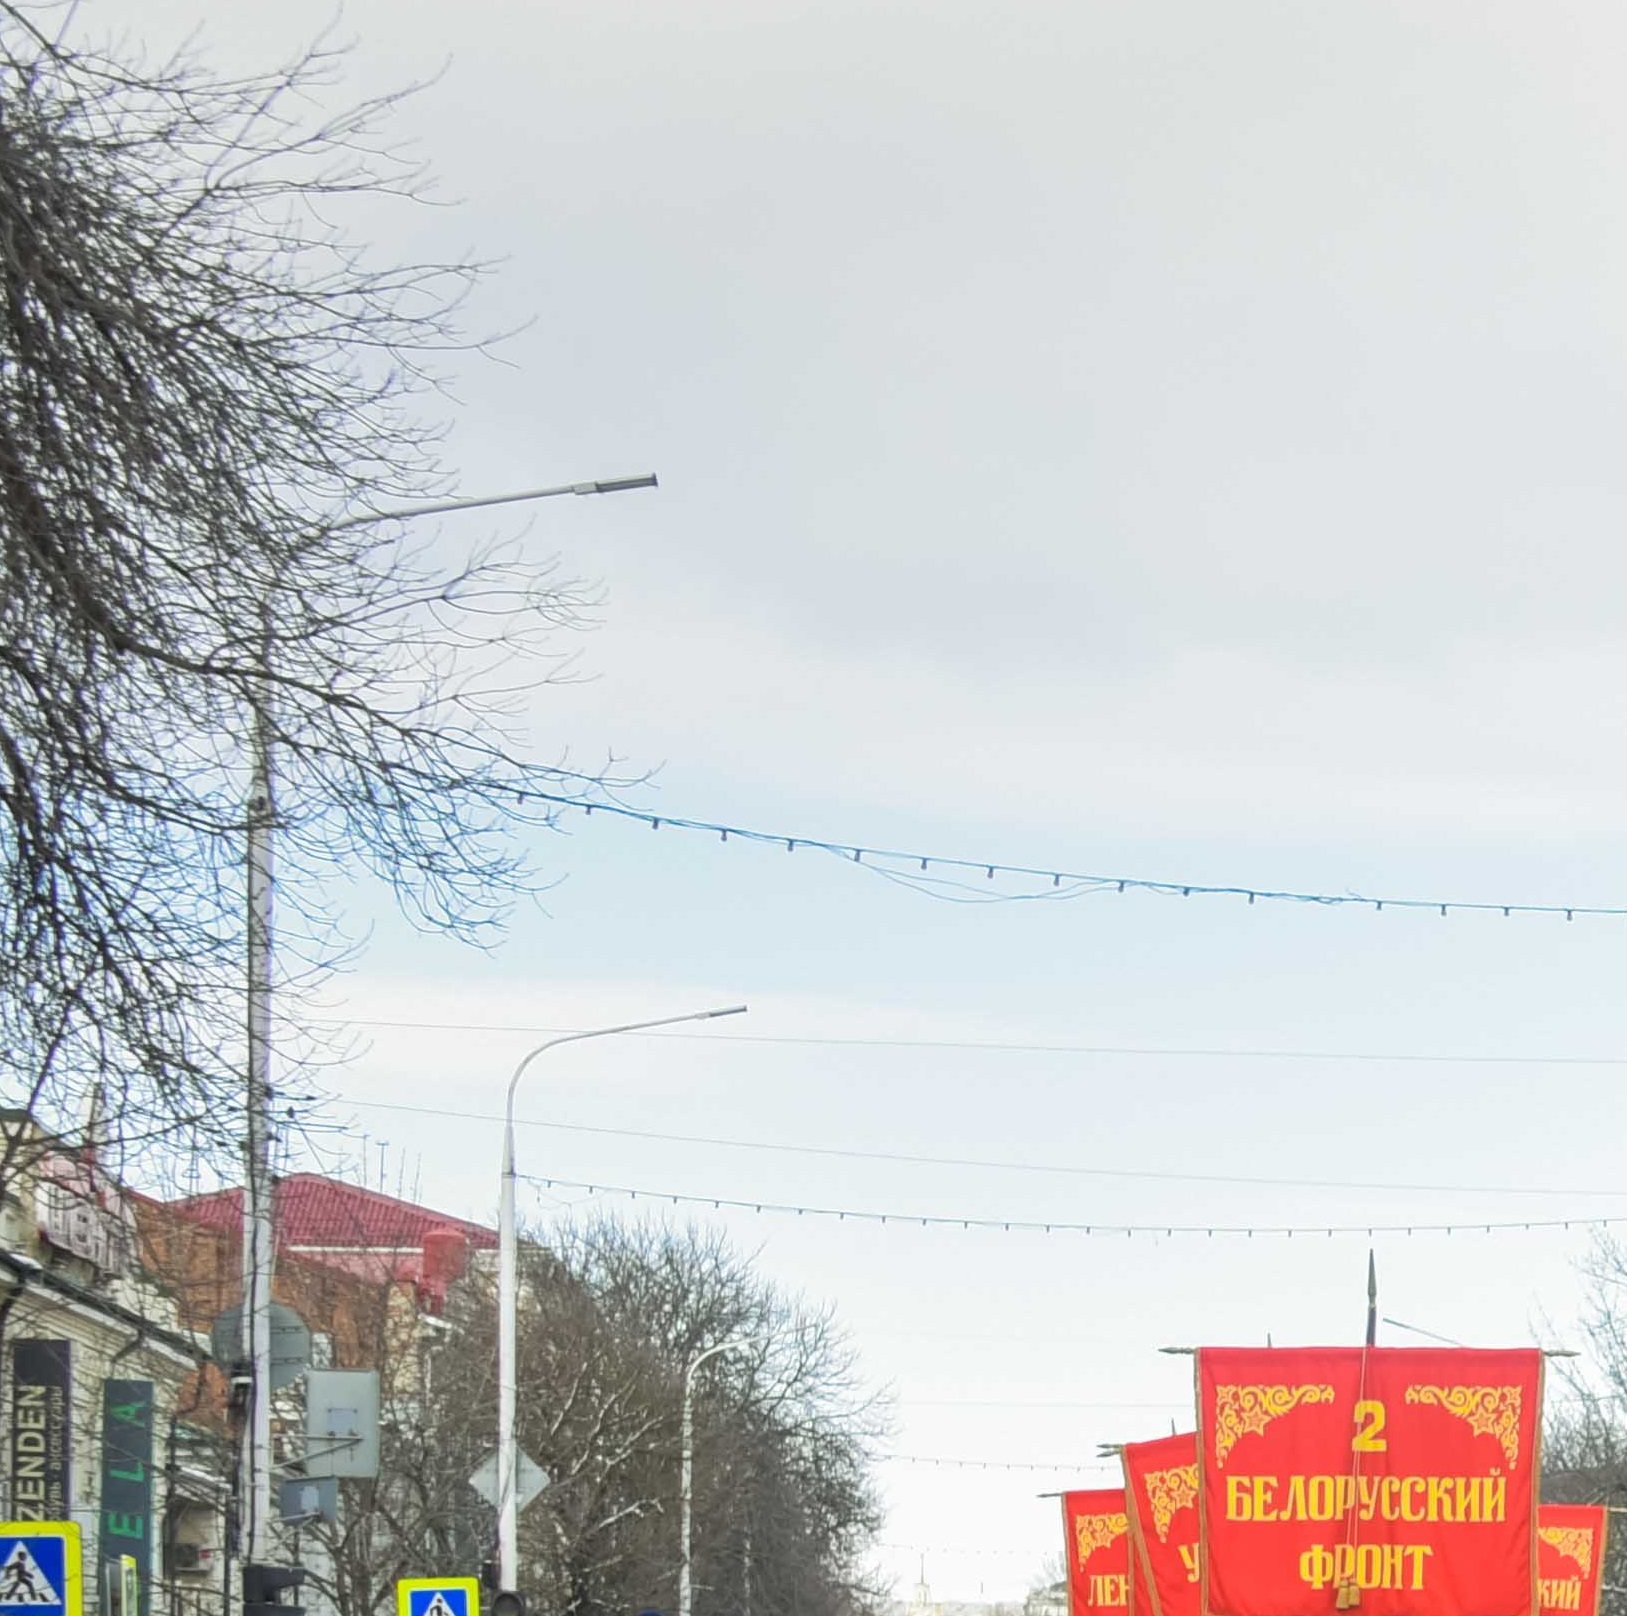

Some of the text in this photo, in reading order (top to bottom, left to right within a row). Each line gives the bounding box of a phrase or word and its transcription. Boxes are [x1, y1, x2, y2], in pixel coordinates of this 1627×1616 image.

[16, 1384, 47, 1520] ZENDEN
[1352, 1400, 1387, 1452] 2
[1226, 1468, 1506, 1523] БЕЛОРУССКИЙ
[1300, 1544, 1432, 1590] ФРОНТ
